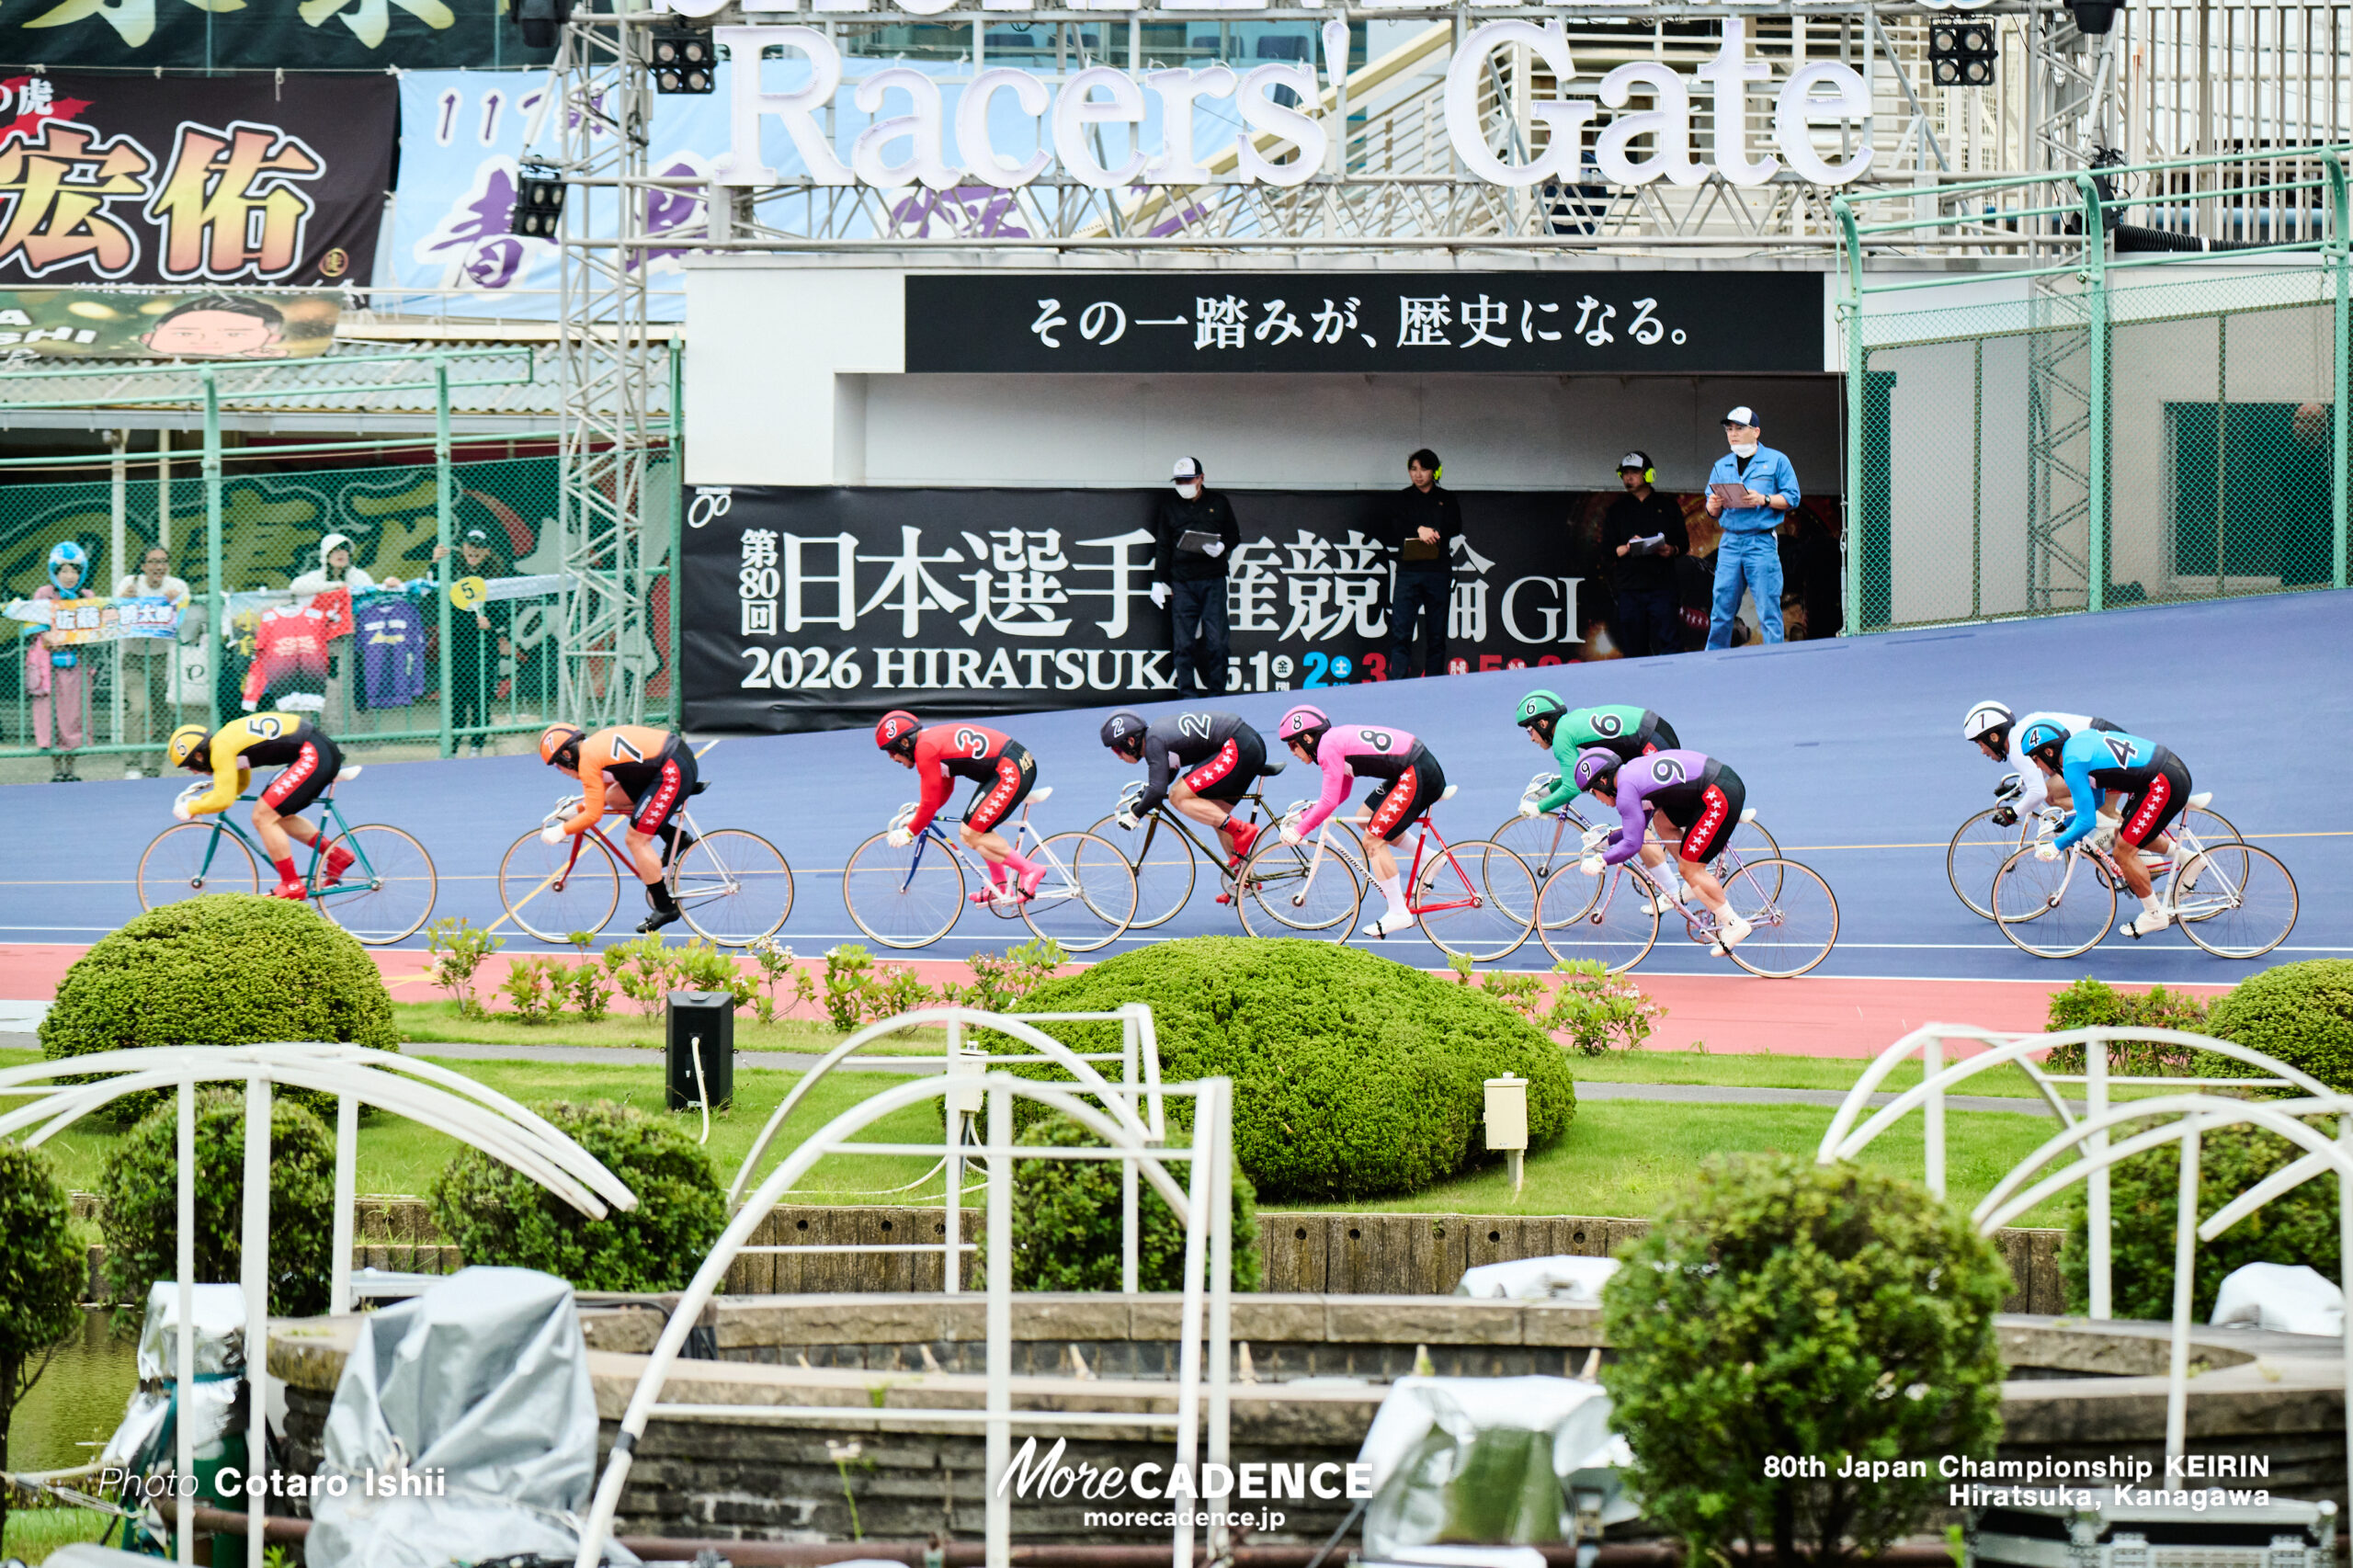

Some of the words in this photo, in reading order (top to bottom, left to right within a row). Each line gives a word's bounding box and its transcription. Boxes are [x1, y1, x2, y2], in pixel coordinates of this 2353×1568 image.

[713, 20, 1350, 188] Racers'
[1445, 18, 1875, 187] Gate
[1030, 294, 1687, 350] その一踏みが、歴史になる。
[460, 582, 475, 599] 5
[739, 528, 780, 636] 第80回
[741, 646, 862, 688] 2026
[1525, 698, 1538, 716] 6
[247, 714, 282, 739] 5
[885, 720, 897, 738] 3
[1112, 717, 1125, 736] 2
[1178, 710, 1211, 741] 2
[1292, 714, 1303, 732] 8
[1589, 712, 1624, 739] 6
[1978, 712, 1985, 730] 1
[610, 733, 644, 764] 7
[955, 727, 990, 759] 3
[1358, 729, 1395, 755] 8
[2029, 728, 2040, 746] 4
[2103, 734, 2140, 770] 4
[1580, 760, 1593, 781] 9
[1651, 757, 1688, 785] 9
